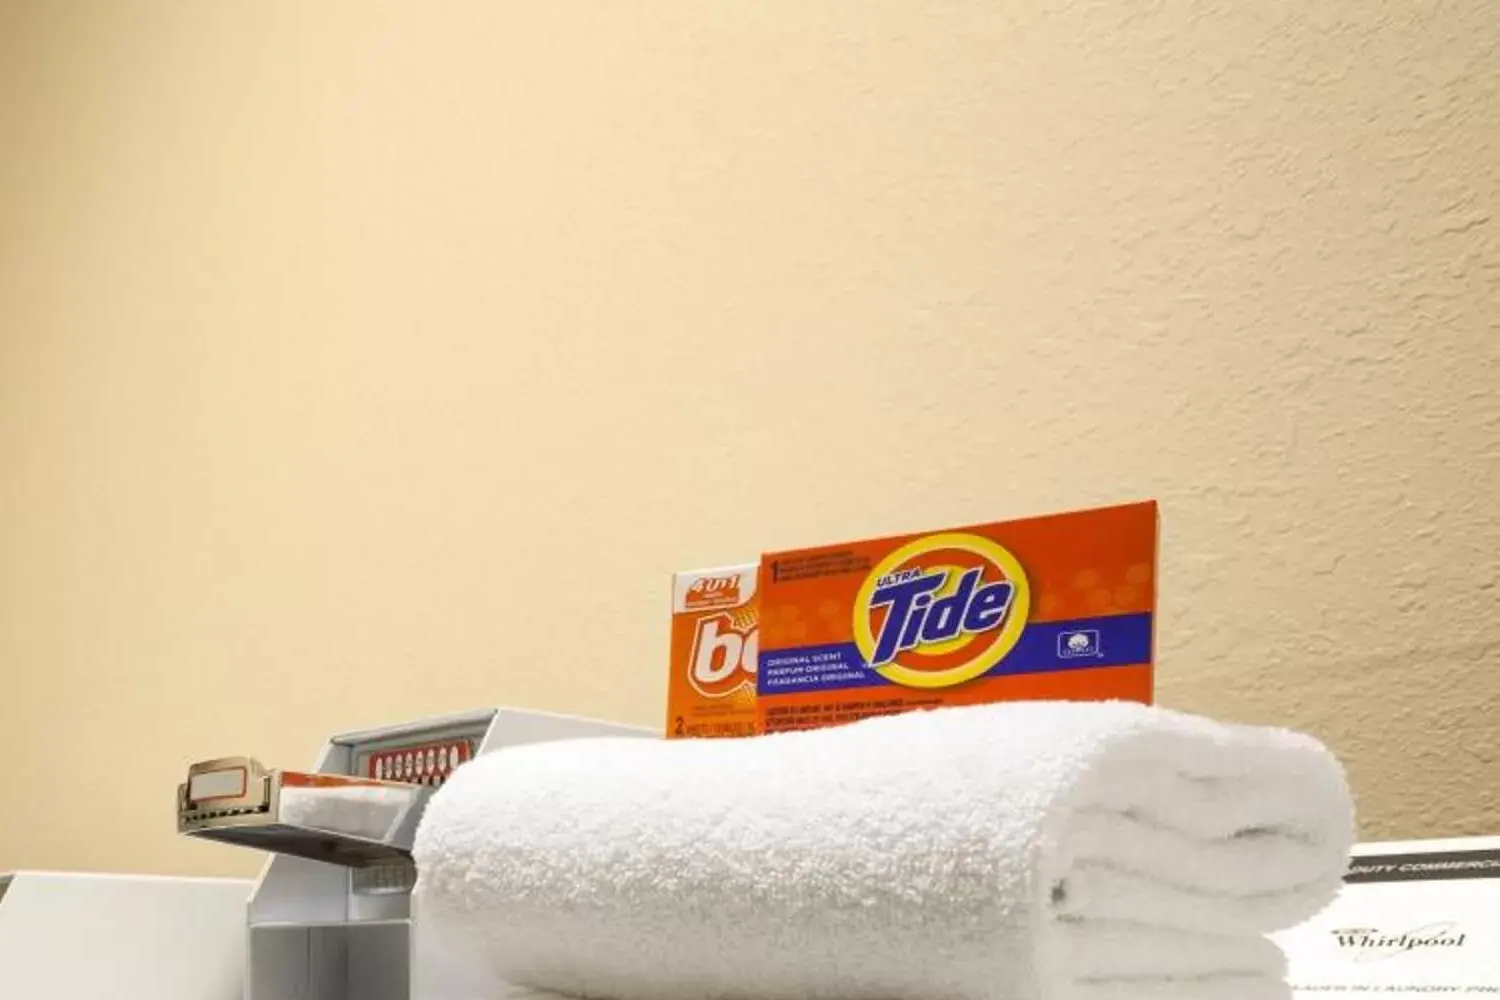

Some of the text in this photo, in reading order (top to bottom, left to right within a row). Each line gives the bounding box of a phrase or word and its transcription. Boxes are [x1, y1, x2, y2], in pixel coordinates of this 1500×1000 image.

[877, 568, 921, 587] ULTRA
[868, 566, 1014, 668] Tide
[767, 652, 841, 667] ORIGINAL SCENT
[805, 661, 849, 673] ORIGINAL
[1337, 933, 1467, 951] Whirlpool
